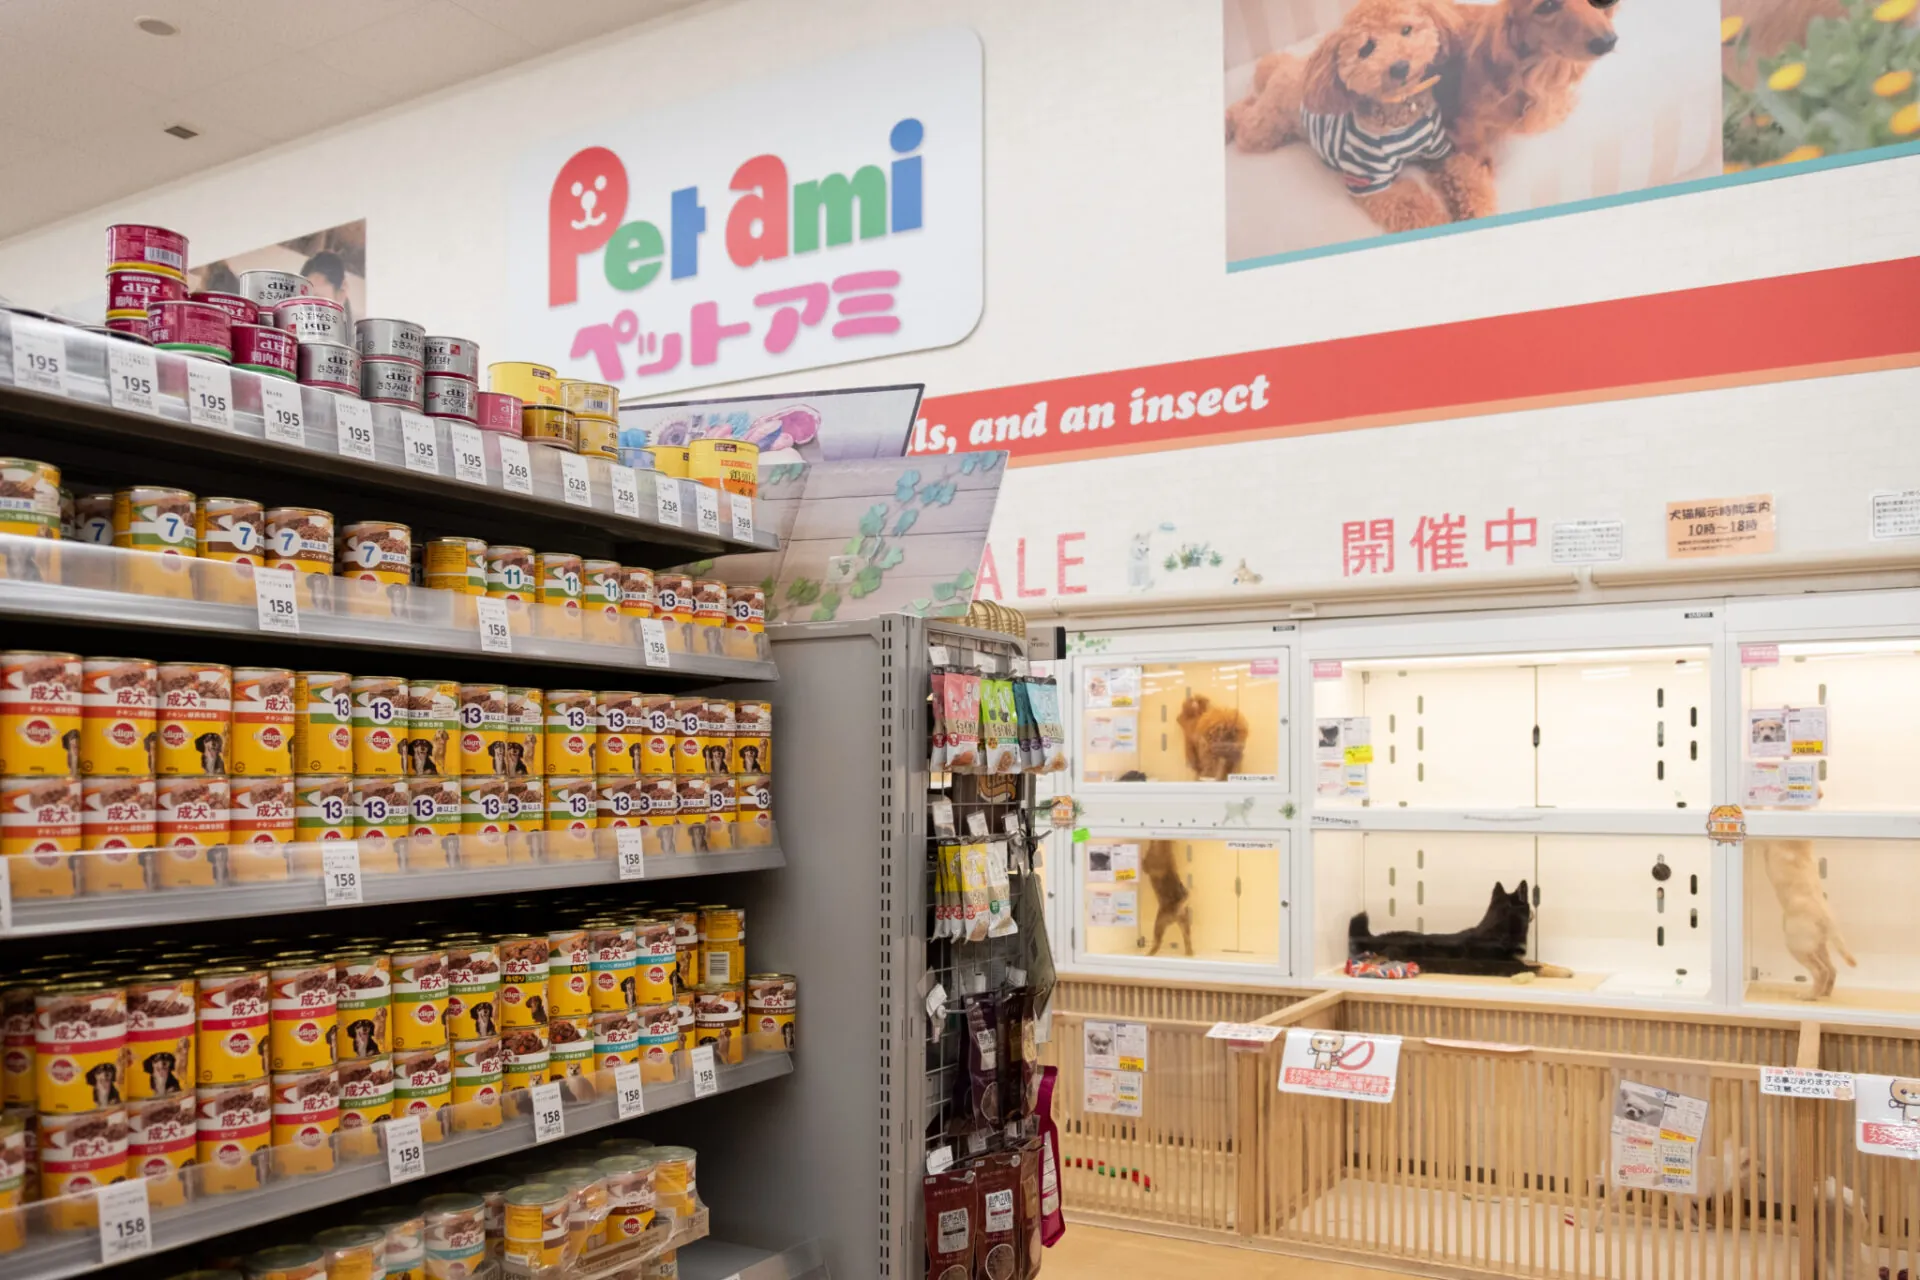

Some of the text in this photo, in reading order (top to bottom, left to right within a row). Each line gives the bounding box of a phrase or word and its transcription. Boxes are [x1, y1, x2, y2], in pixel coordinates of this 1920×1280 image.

[549, 117, 924, 307] Pet ami
[268, 281, 296, 293] dbf
[570, 270, 901, 381] ペットアミ
[259, 340, 293, 354] dbf
[27, 353, 59, 373] 195
[327, 355, 353, 366] dbf
[386, 371, 413, 382] dbf
[121, 375, 152, 394] 195
[446, 388, 466, 398] db
[199, 393, 226, 411] 195
[276, 409, 300, 426] 195
[908, 374, 1270, 453] ls, and an insect
[348, 426, 371, 443] 195
[413, 441, 434, 457] 195
[462, 452, 482, 468] 195
[508, 463, 528, 478] 268
[568, 478, 587, 492] 628
[618, 489, 635, 502] 258
[661, 500, 678, 512] 258
[1669, 501, 1770, 521] 犬猫展示時間案内
[702, 509, 718, 521] 258
[737, 516, 751, 529] 398
[92, 523, 106, 541] 7
[165, 517, 179, 537] 7
[239, 527, 252, 545] 7
[280, 533, 294, 551] 7
[1341, 507, 1537, 577] 開催中
[363, 546, 376, 562] 7
[504, 569, 521, 586] 11
[565, 576, 578, 591] 11
[604, 582, 618, 598] 11
[269, 599, 294, 614] 158
[659, 593, 676, 607] 13
[733, 603, 749, 618] 13
[488, 624, 506, 636] 158
[650, 643, 665, 654] 158
[166, 693, 207, 708] 成犬用
[334, 698, 349, 717] 13
[370, 702, 392, 719] 13
[461, 707, 481, 724] 13
[567, 711, 585, 727] 13
[606, 713, 625, 728] 13
[649, 714, 665, 728] 13
[682, 717, 698, 731] 13
[481, 798, 500, 814] 13
[508, 798, 519, 814] 3
[569, 798, 587, 811] 13
[613, 796, 630, 811] 13
[640, 796, 650, 810] 3
[710, 793, 722, 808] 13
[756, 793, 768, 805] 13
[177, 804, 216, 820] 成犬用
[322, 800, 343, 818] 13
[364, 800, 386, 818] 13
[413, 799, 434, 816] 13
[624, 853, 640, 865] 158
[334, 873, 356, 887] 158
[336, 985, 357, 999] 犬用
[501, 1051, 520, 1063] 犬用
[699, 1070, 713, 1082] 158
[1765, 1075, 1850, 1088] する事がありますので
[344, 1083, 379, 1097] 成犬用
[624, 1089, 640, 1102] 158
[1764, 1084, 1831, 1095] ご注意ください
[543, 1110, 560, 1124] 158
[399, 1146, 420, 1162] 158
[116, 1218, 146, 1238] 158
